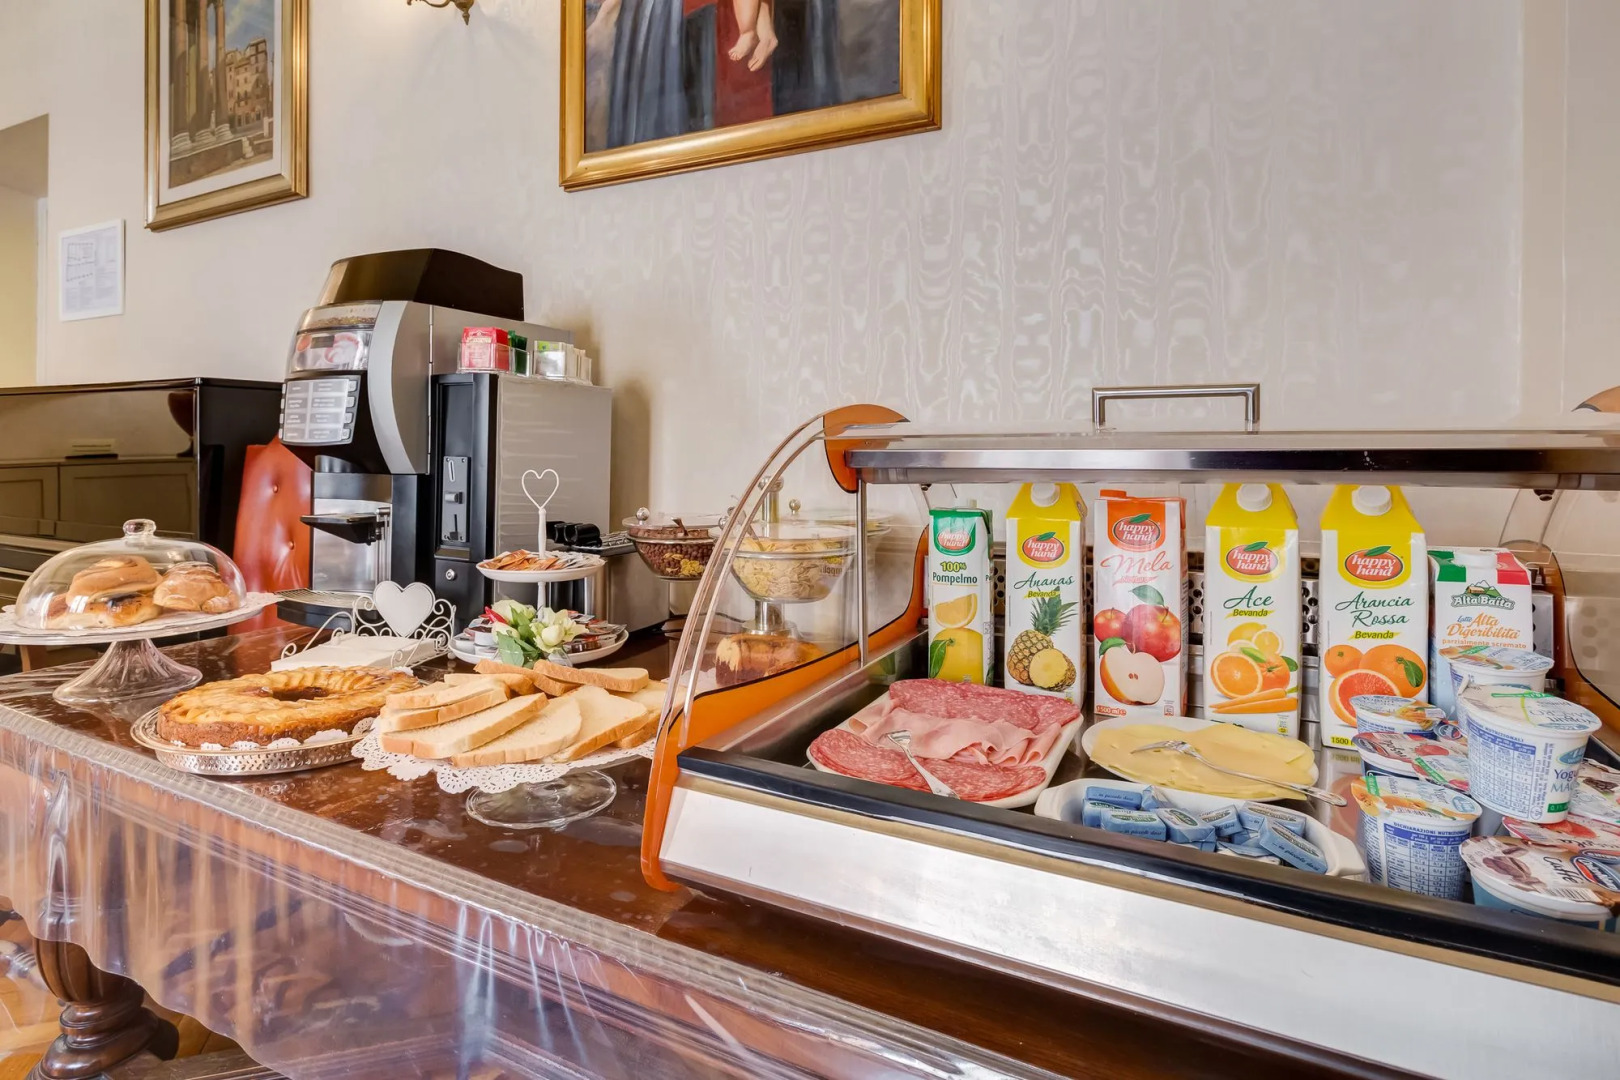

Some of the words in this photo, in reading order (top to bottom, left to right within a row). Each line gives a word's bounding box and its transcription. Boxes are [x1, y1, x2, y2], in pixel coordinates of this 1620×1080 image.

[1118, 521, 1155, 534] happy
[1122, 531, 1153, 541] hand
[1027, 539, 1060, 551] happy
[1030, 548, 1058, 558] hand
[1231, 549, 1272, 563] happy
[940, 560, 967, 572] 100%
[1099, 551, 1175, 575] Mela
[1236, 559, 1270, 571] hand
[1351, 554, 1396, 569] happy
[1355, 564, 1394, 576] hand
[932, 571, 978, 585] Pompelmo
[1013, 571, 1075, 590] Ananas
[1222, 585, 1274, 609] Ace
[1334, 590, 1415, 611] Arancia
[1453, 594, 1478, 605] Alta
[1479, 595, 1513, 609] Baita
[1232, 608, 1268, 617] Bevanda
[1350, 609, 1410, 628] Rossa
[1466, 611, 1500, 627] Alta
[1354, 630, 1395, 639] Bevanda
[1442, 638, 1490, 646] parzialmente
[1491, 641, 1527, 649] scremato
[1331, 736, 1349, 745] 1500
